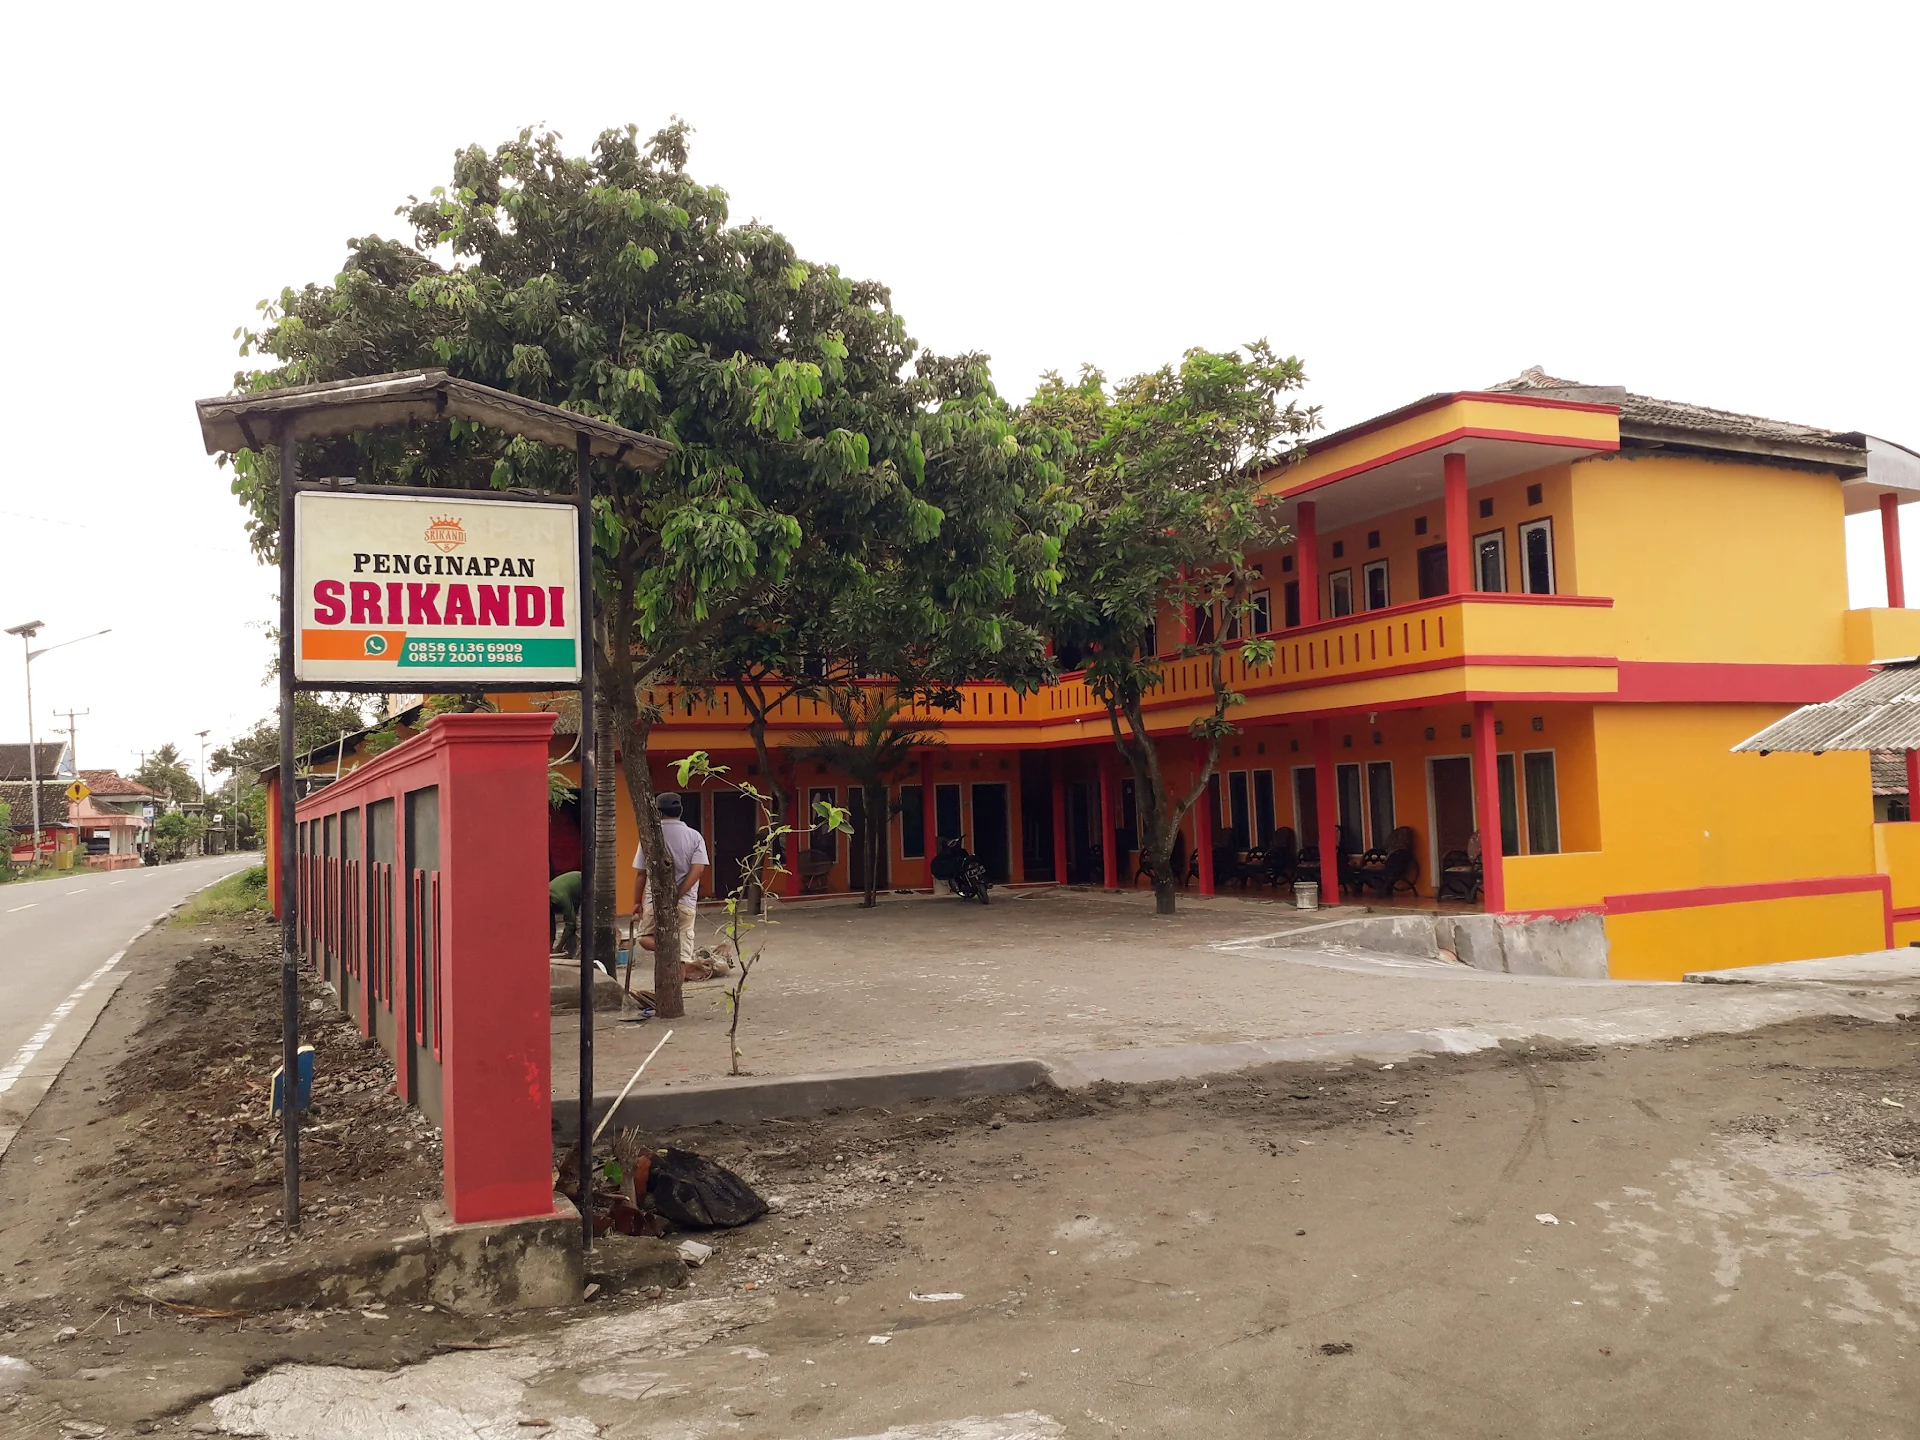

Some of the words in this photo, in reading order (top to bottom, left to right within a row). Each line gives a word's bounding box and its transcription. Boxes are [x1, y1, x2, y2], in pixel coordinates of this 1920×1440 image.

[424, 529, 467, 543] SRIKANDI
[353, 553, 535, 578] PENGINAPAN
[313, 579, 565, 628] SRIKANDI
[408, 642, 446, 652] 0858
[448, 642, 485, 653] 6136
[487, 643, 523, 653] 6909
[408, 652, 446, 662] 0857
[449, 652, 483, 663] 2001
[487, 653, 523, 663] 9986
